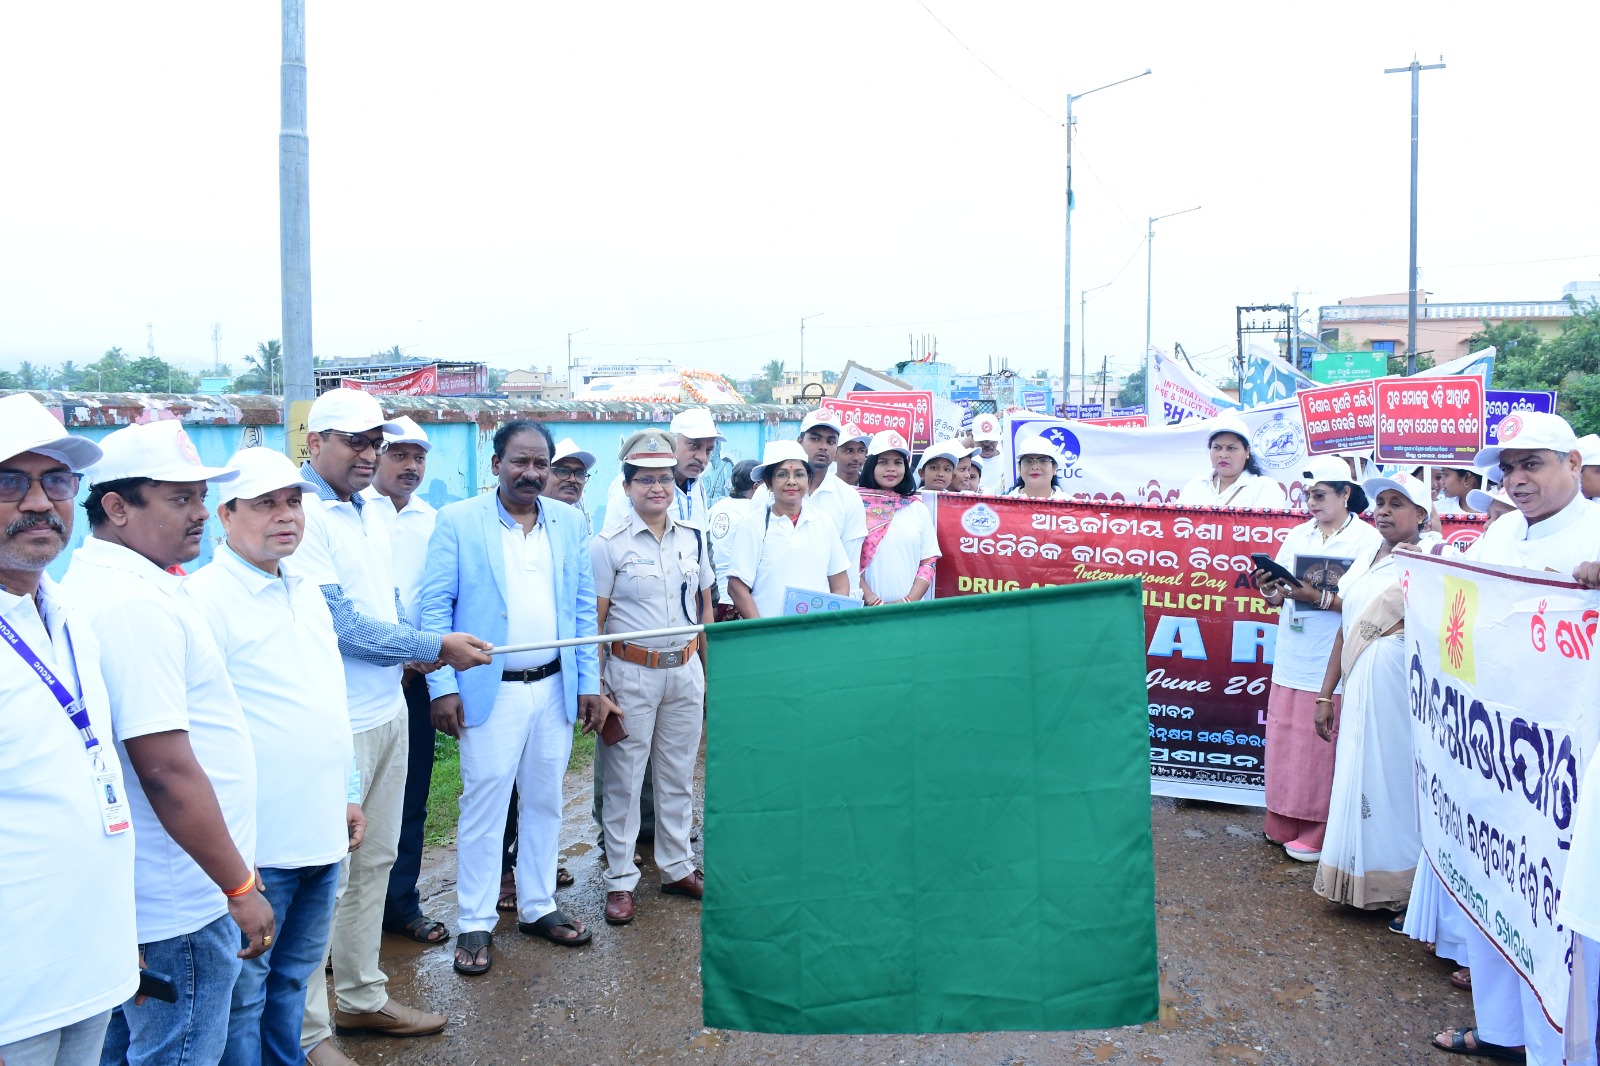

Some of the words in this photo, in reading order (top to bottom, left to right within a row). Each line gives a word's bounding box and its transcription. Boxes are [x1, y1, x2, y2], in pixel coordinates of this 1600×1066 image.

[1178, 395, 1203, 412] ILLICIT
[1031, 513, 1164, 539] ଆନ୍ତର୍ଜାତୀୟ
[1173, 517, 1223, 541] ନିଶା
[959, 533, 1062, 560] ଅନୈତିକ
[1071, 545, 1179, 569] କାରବାର
[958, 576, 1021, 594] DRUG
[1073, 563, 1184, 586] International
[1190, 571, 1228, 592] Day
[1142, 590, 1227, 612] ILLICIT
[33, 661, 56, 685] PECUC
[1146, 668, 1212, 692] June
[1147, 703, 1195, 720] ଜୀବନ
